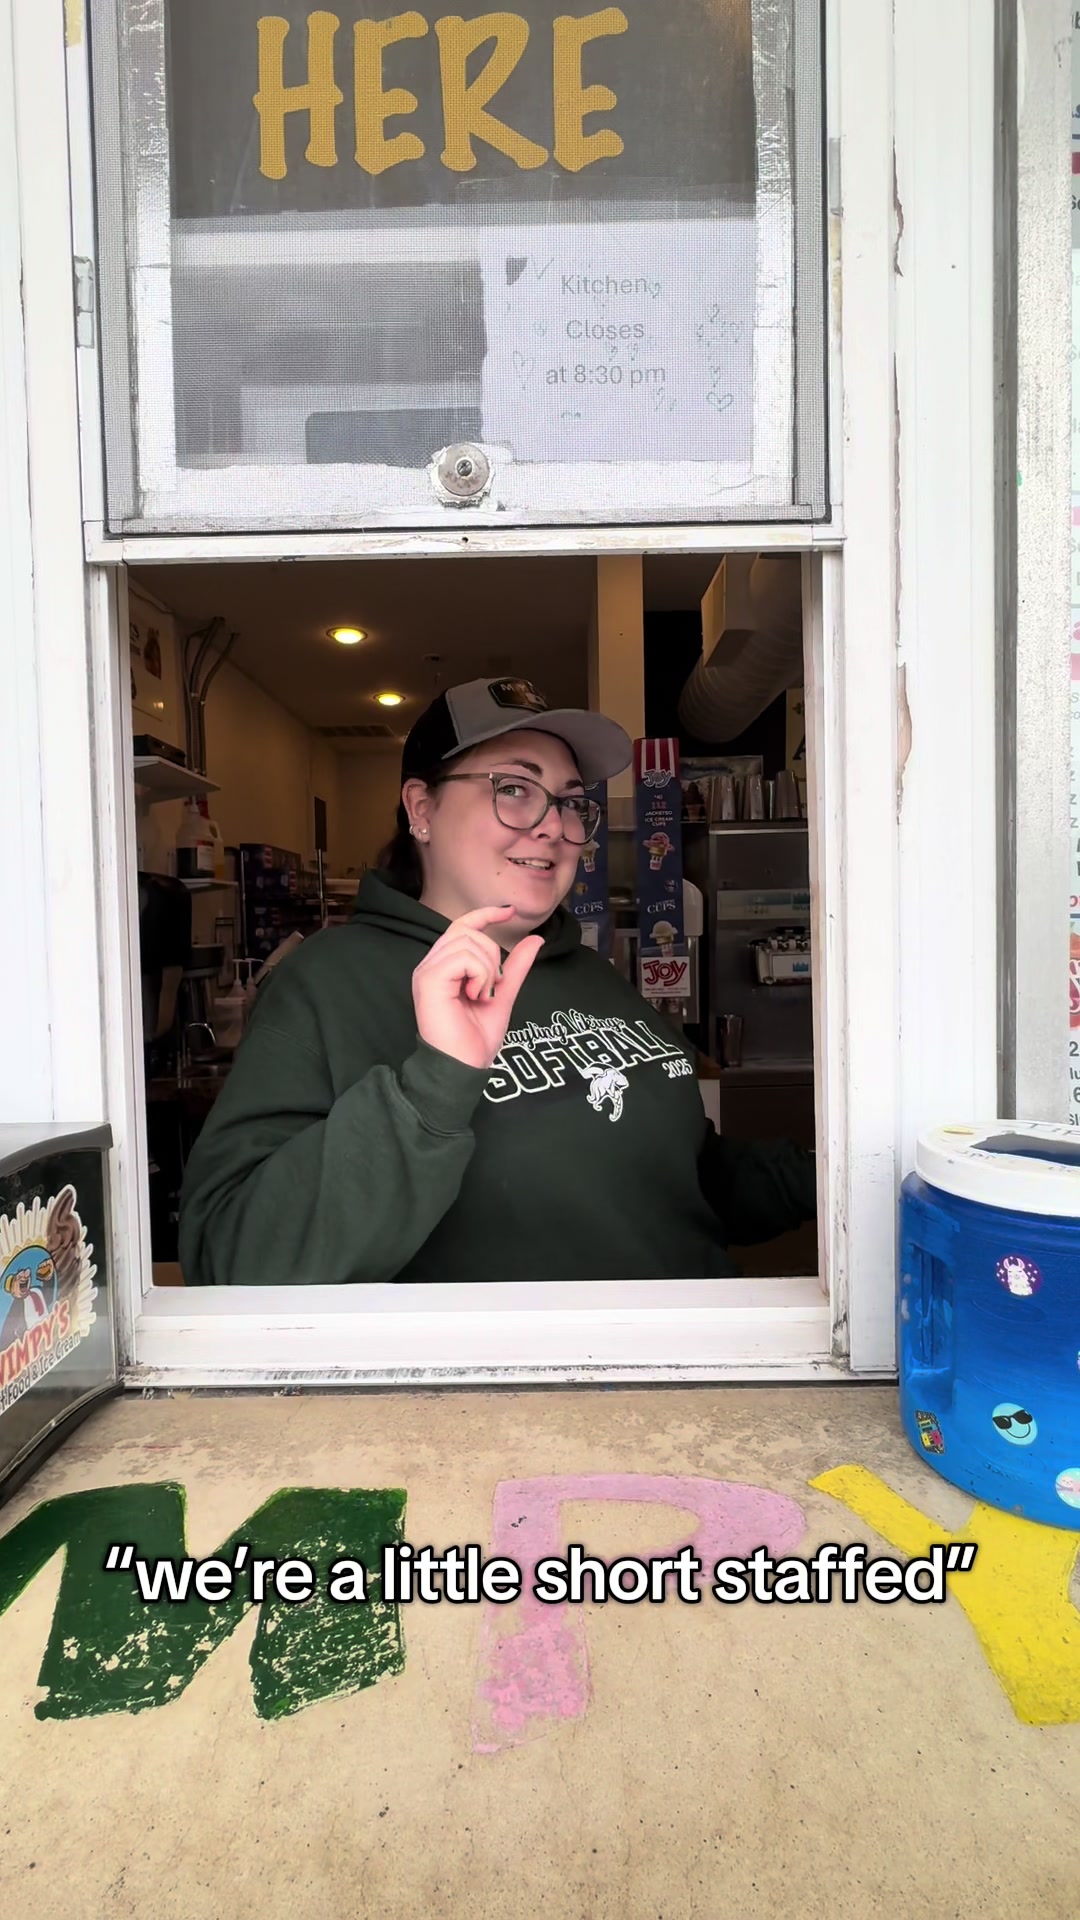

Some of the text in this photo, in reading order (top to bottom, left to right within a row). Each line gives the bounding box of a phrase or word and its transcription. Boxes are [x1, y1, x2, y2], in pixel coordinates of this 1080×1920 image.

[253, 7, 628, 180] HERE
[561, 275, 647, 295] Kitchen
[566, 319, 645, 339] Closes
[545, 364, 666, 388] at 8:30 pm
[574, 903, 604, 915] CUPS
[646, 902, 676, 914] CUPS
[551, 1008, 626, 1033] Vikings
[483, 1020, 684, 1103] SOFTBALL
[661, 1058, 693, 1079] 2025
[8, 1366, 31, 1405] Food
[39, 1352, 56, 1376] Ice
[55, 1332, 81, 1360] Cream
